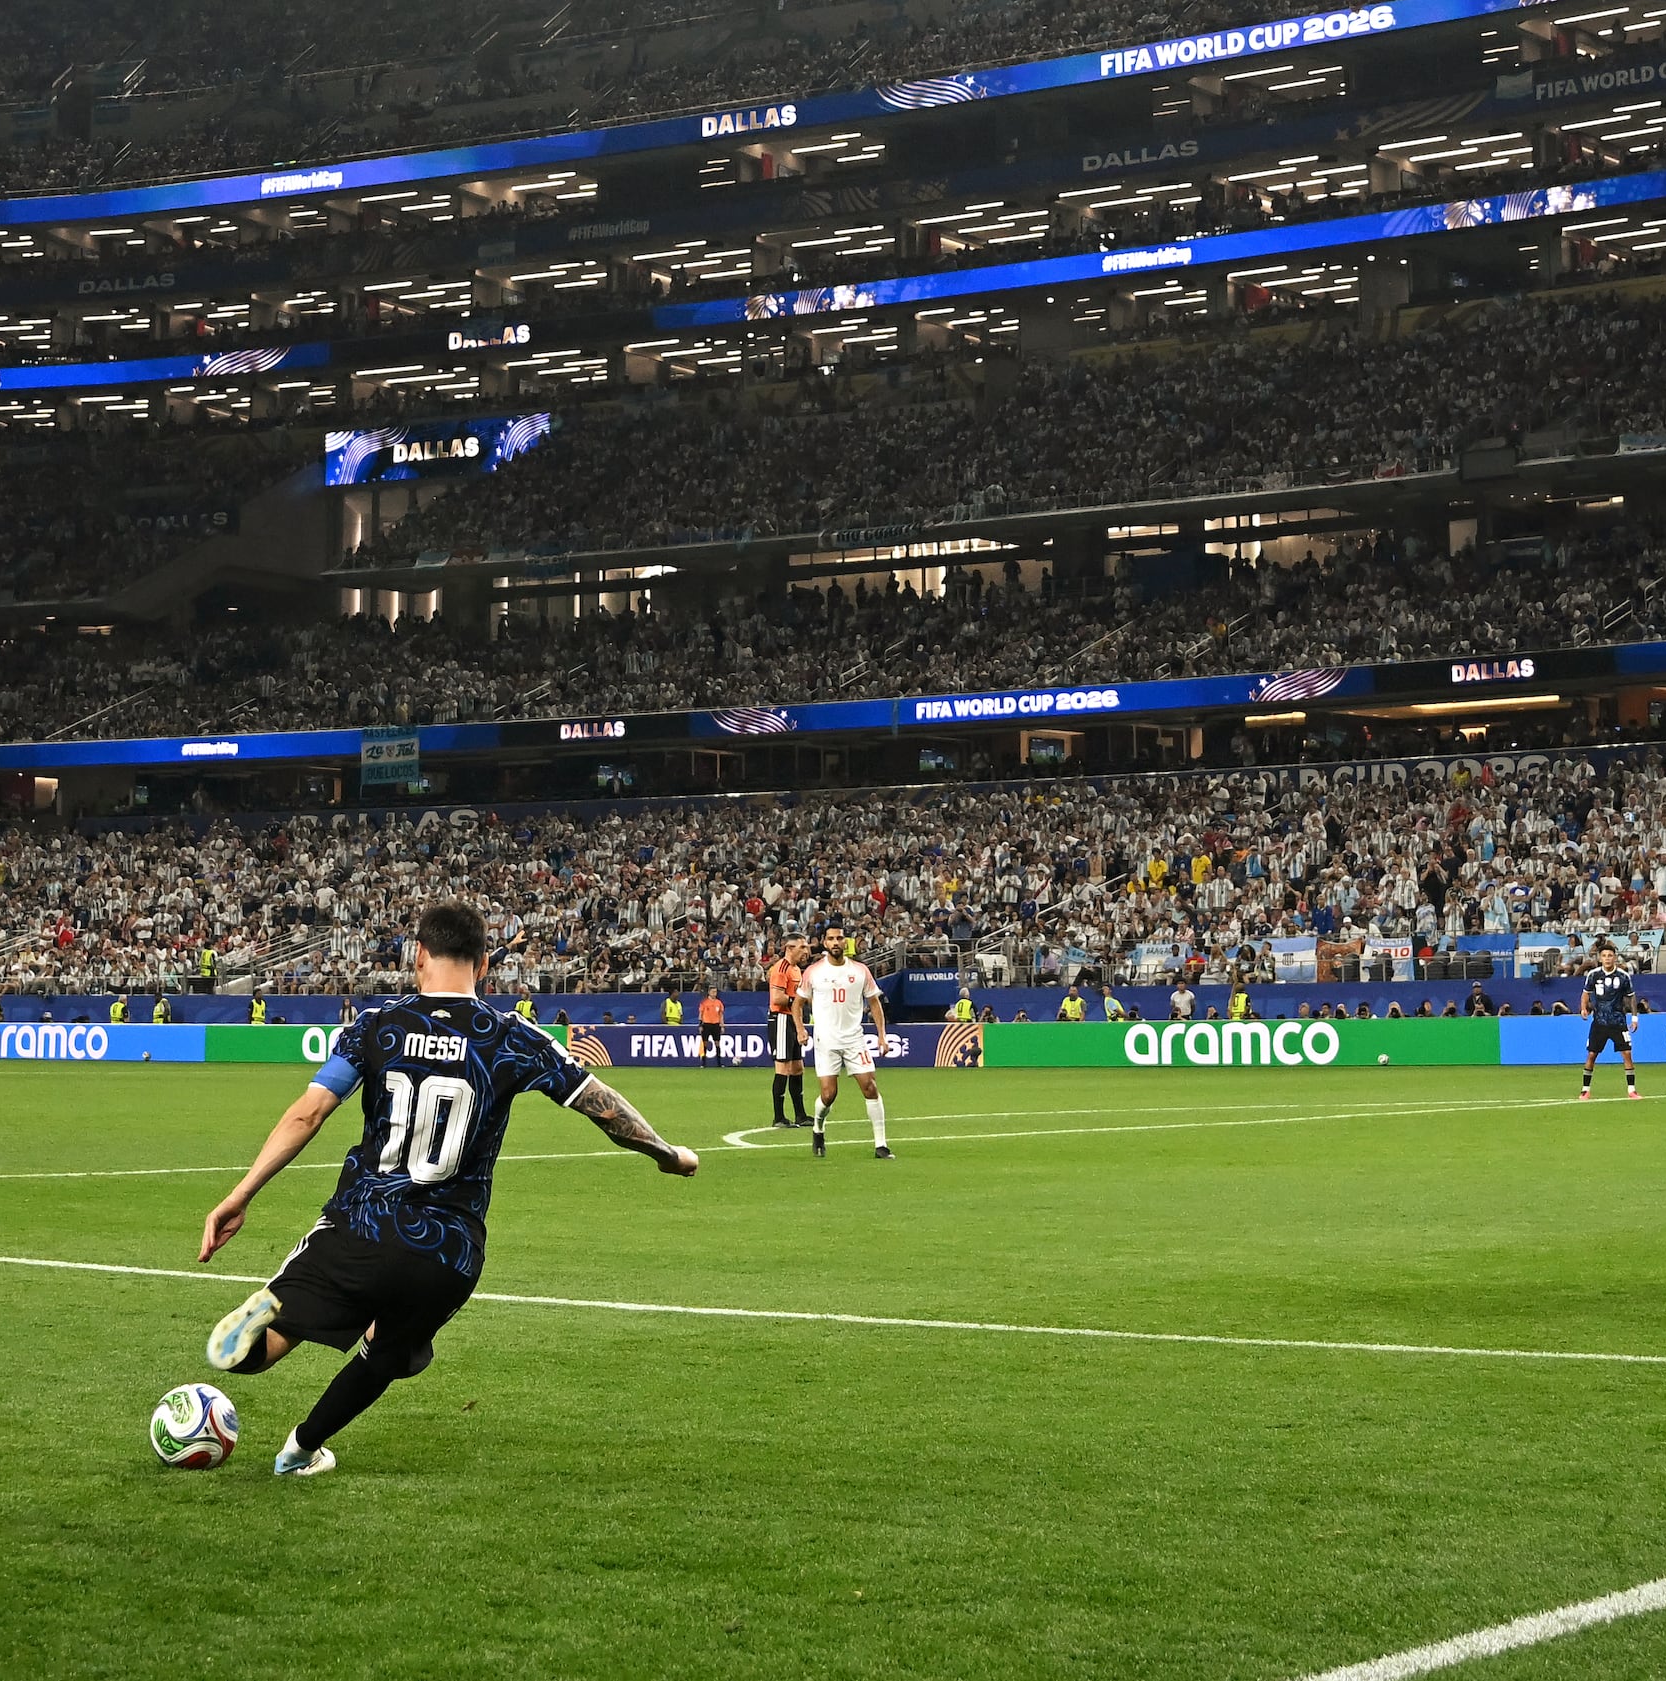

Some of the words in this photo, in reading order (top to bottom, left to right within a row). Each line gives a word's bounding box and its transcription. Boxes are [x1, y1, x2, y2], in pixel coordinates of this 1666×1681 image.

[1100, 52, 1154, 77] FIFA
[1156, 31, 1245, 67] WORLD
[1248, 21, 1300, 50] CUP
[1302, 5, 1393, 41] 2026
[1535, 78, 1578, 102] FIFA
[1580, 63, 1655, 93] WORLD
[701, 105, 797, 137] DALLAS
[1082, 140, 1199, 171] DALLAS
[78, 272, 175, 294] DALLAS
[393, 435, 479, 463] DALLAS
[1452, 658, 1534, 683] DALLAS
[916, 700, 953, 721] FIFA
[954, 696, 1017, 718] WORLD
[1019, 693, 1053, 713] CUP
[1055, 689, 1119, 711] 2026
[560, 721, 626, 740] DALLAS
[908, 973, 926, 982] FIFA
[926, 973, 953, 982] WORLD
[832, 988, 846, 1003] 10
[404, 1032, 467, 1062] MESSI
[631, 1034, 679, 1058] FIFA
[858, 1050, 871, 1065] 10
[1124, 1022, 1340, 1065] aramco
[378, 1071, 475, 1185] 10
